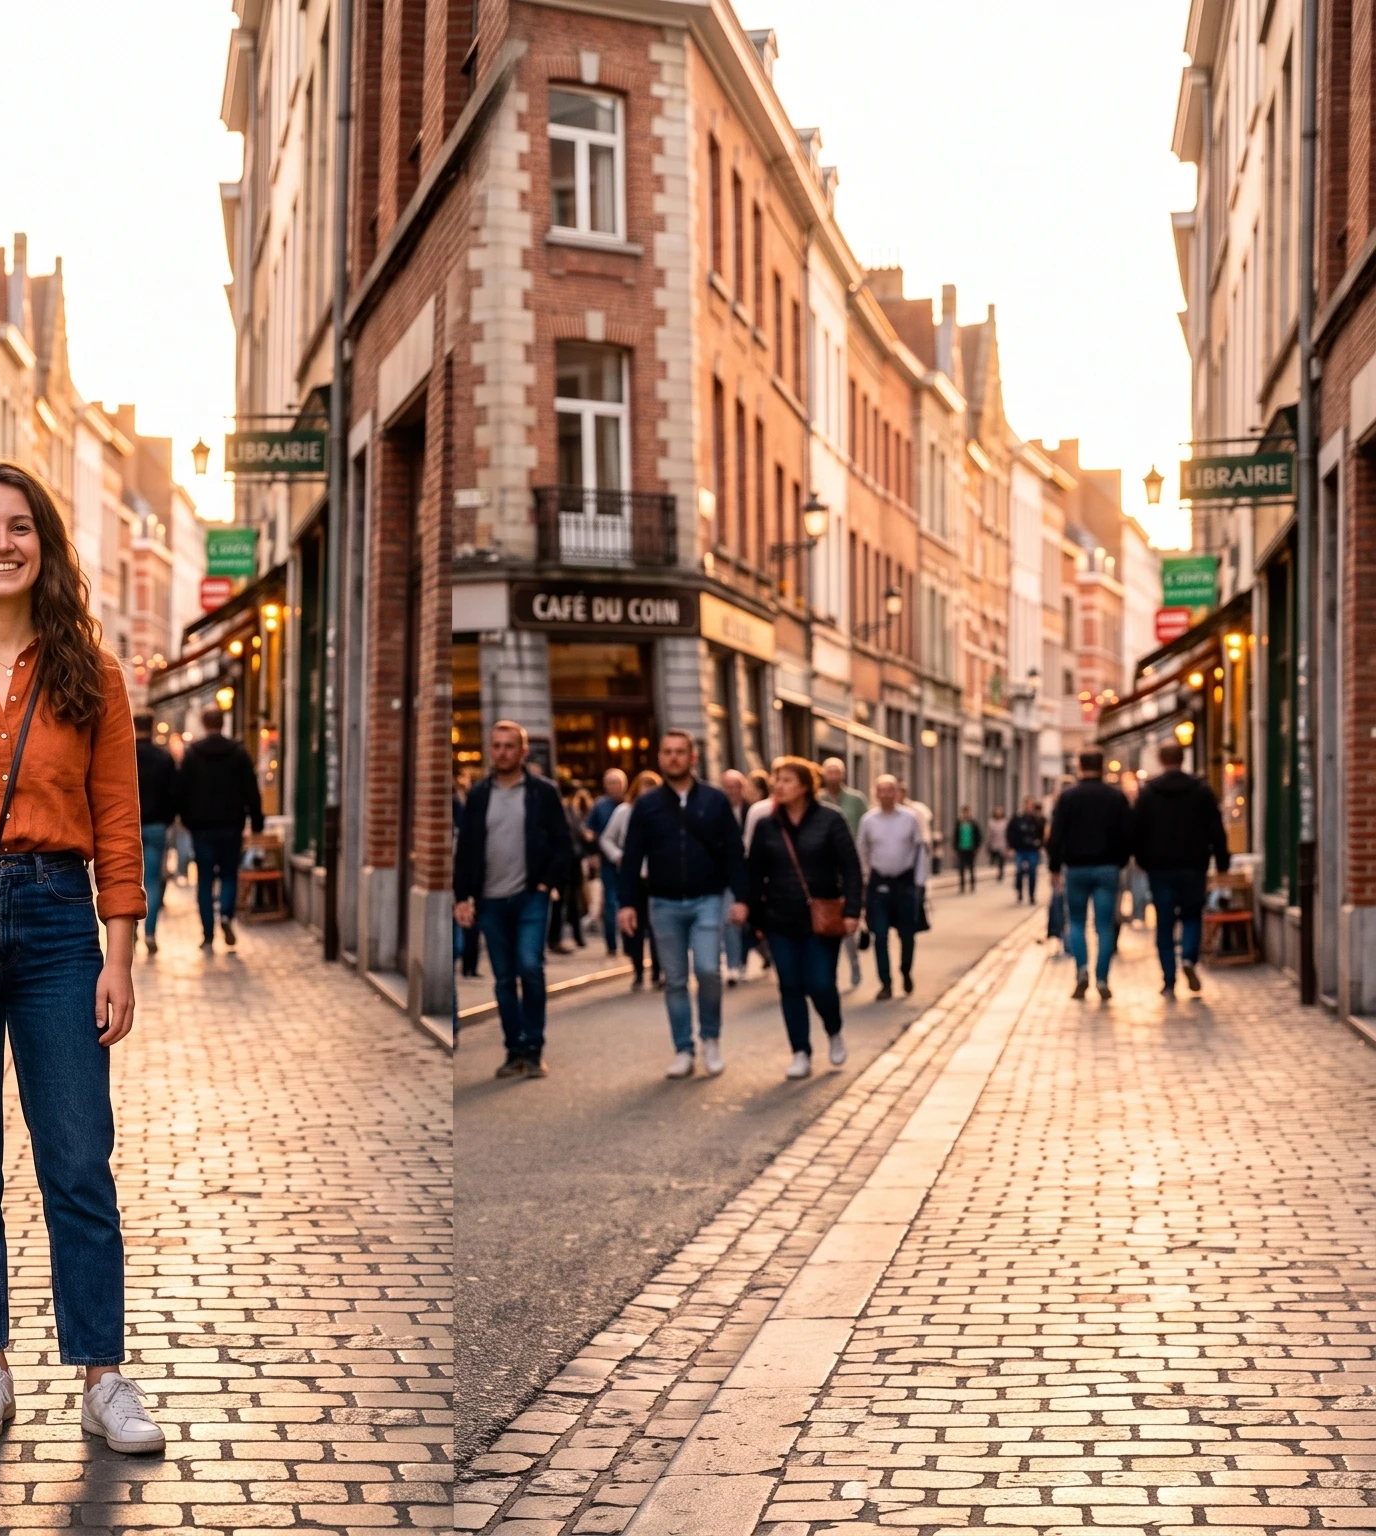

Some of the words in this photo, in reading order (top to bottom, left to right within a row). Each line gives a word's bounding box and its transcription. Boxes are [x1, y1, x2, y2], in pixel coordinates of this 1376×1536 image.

[227, 440, 322, 463] LIBRAIRIE
[1184, 463, 1289, 490] LIBRAIRIE
[531, 591, 588, 623] CAFÉ
[591, 596, 623, 623] DU
[627, 597, 681, 626] COIN
